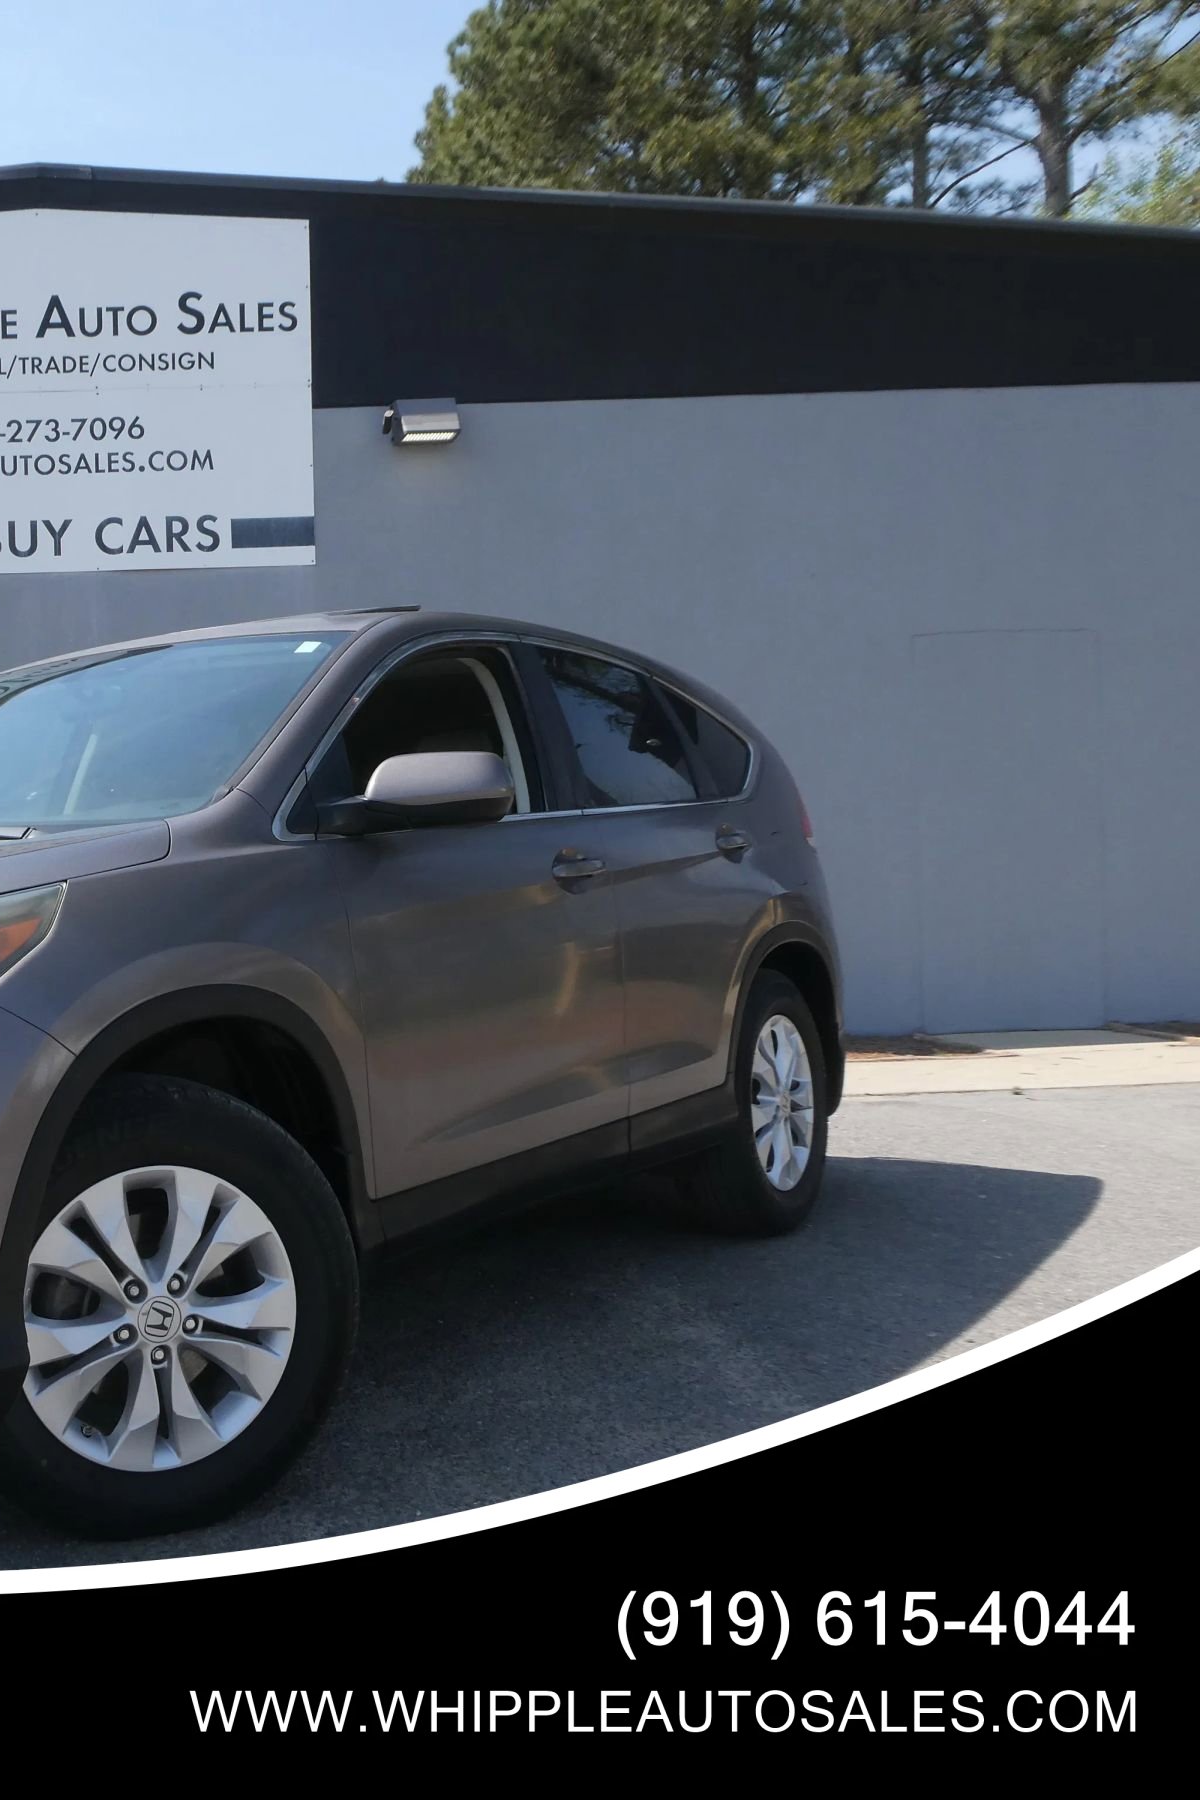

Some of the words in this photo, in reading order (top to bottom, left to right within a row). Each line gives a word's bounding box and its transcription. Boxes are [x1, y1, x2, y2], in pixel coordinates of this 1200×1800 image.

[36, 294, 158, 339] AUTO
[176, 291, 298, 335] SALES
[94, 514, 220, 555] CARS
